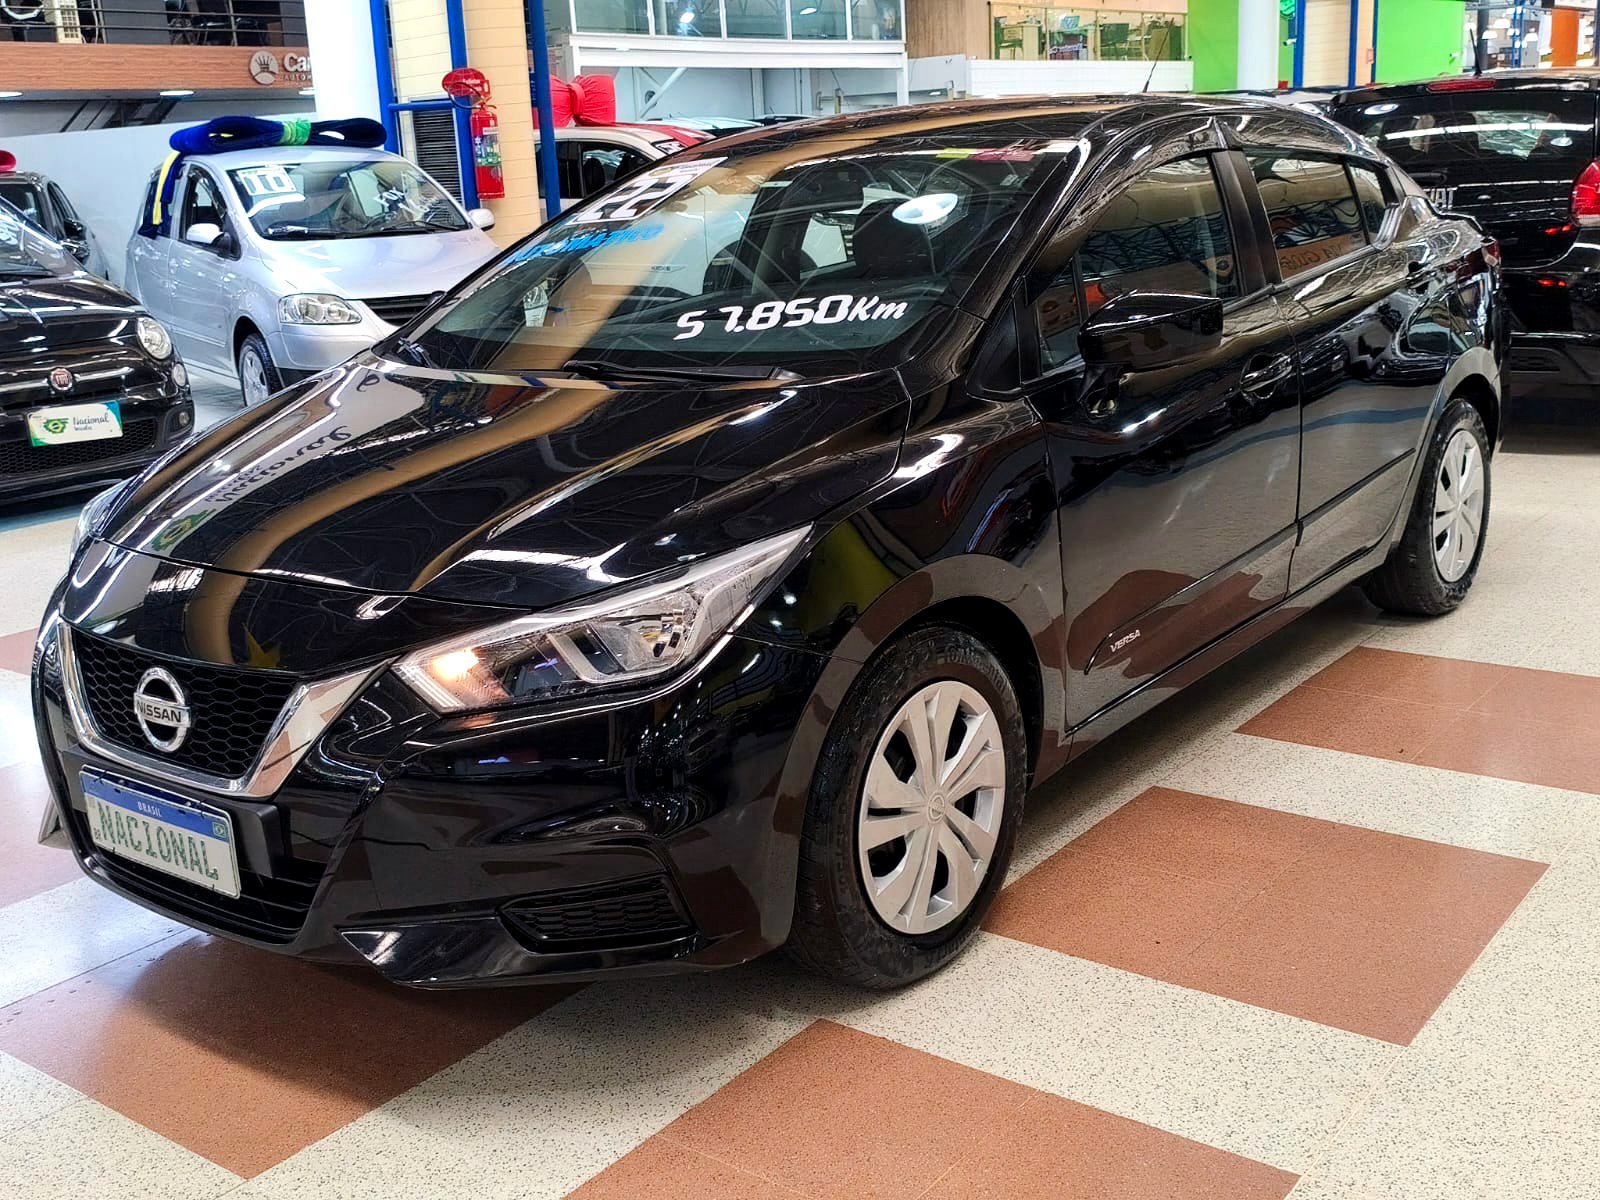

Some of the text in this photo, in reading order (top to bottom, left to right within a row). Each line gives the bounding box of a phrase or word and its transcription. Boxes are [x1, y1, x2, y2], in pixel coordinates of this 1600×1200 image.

[1422, 186, 1458, 210] IAT
[1110, 629, 1141, 652] VERSA
[136, 699, 182, 723] NISSAN
[137, 801, 162, 818] BRASIL
[98, 802, 219, 881] NACIONAL
